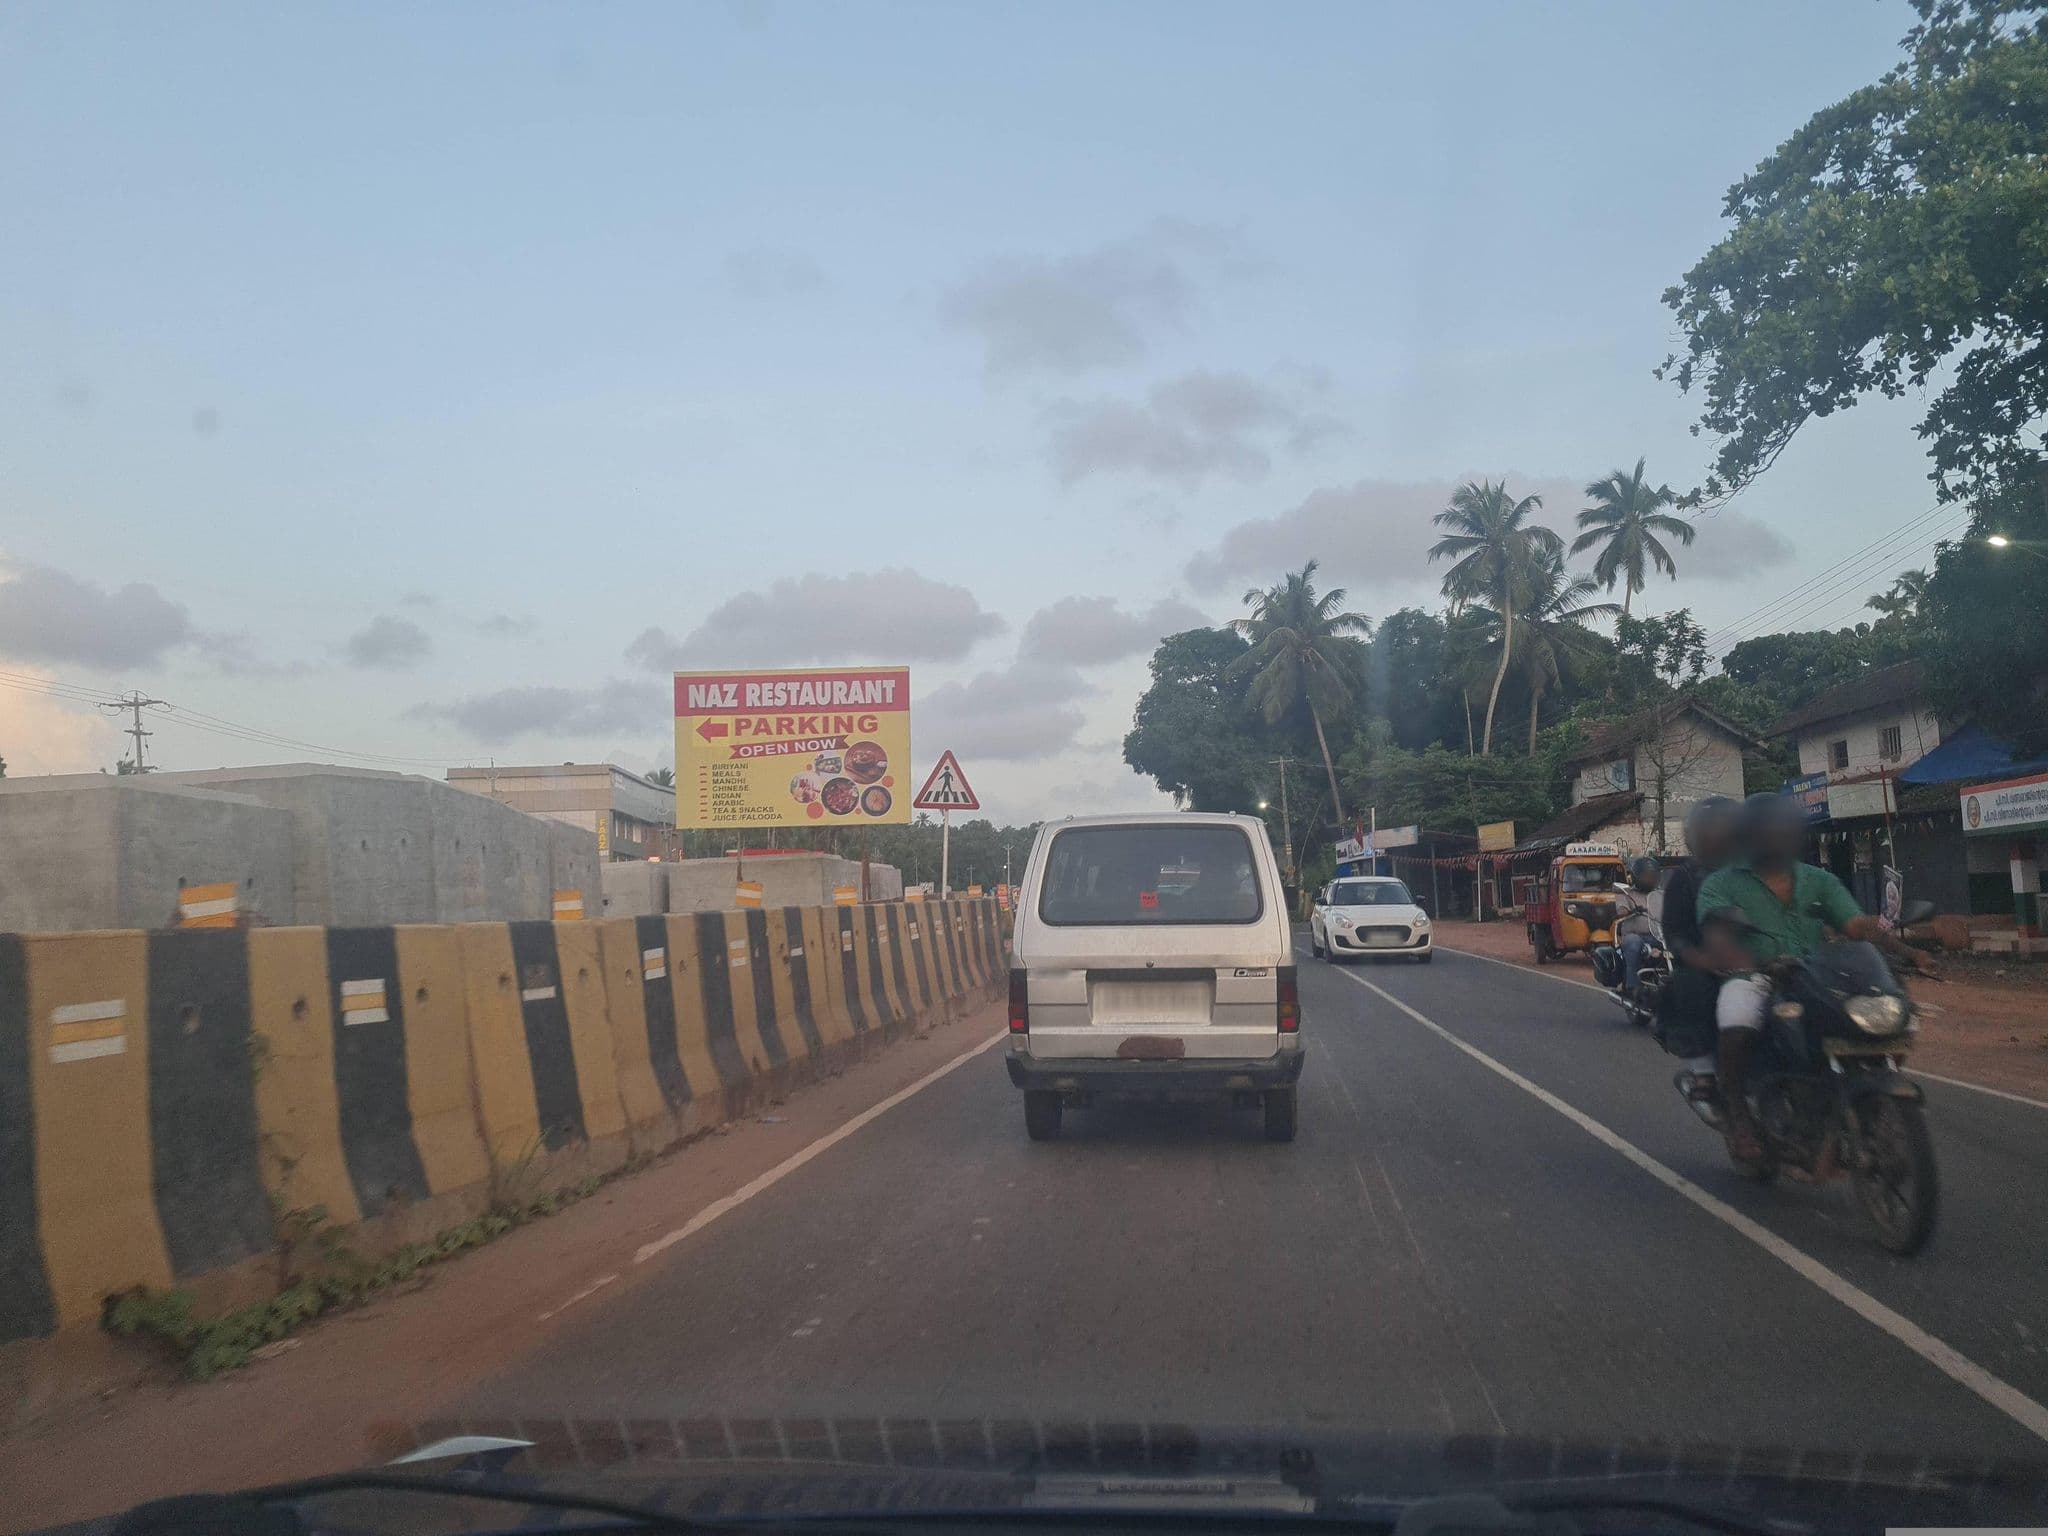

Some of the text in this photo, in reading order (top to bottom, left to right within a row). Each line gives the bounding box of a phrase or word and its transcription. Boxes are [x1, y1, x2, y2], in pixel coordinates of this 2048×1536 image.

[688, 680, 895, 708] NAZ RESTAURANT
[735, 714, 878, 736] PARKING
[739, 738, 836, 757] OPEN NOW
